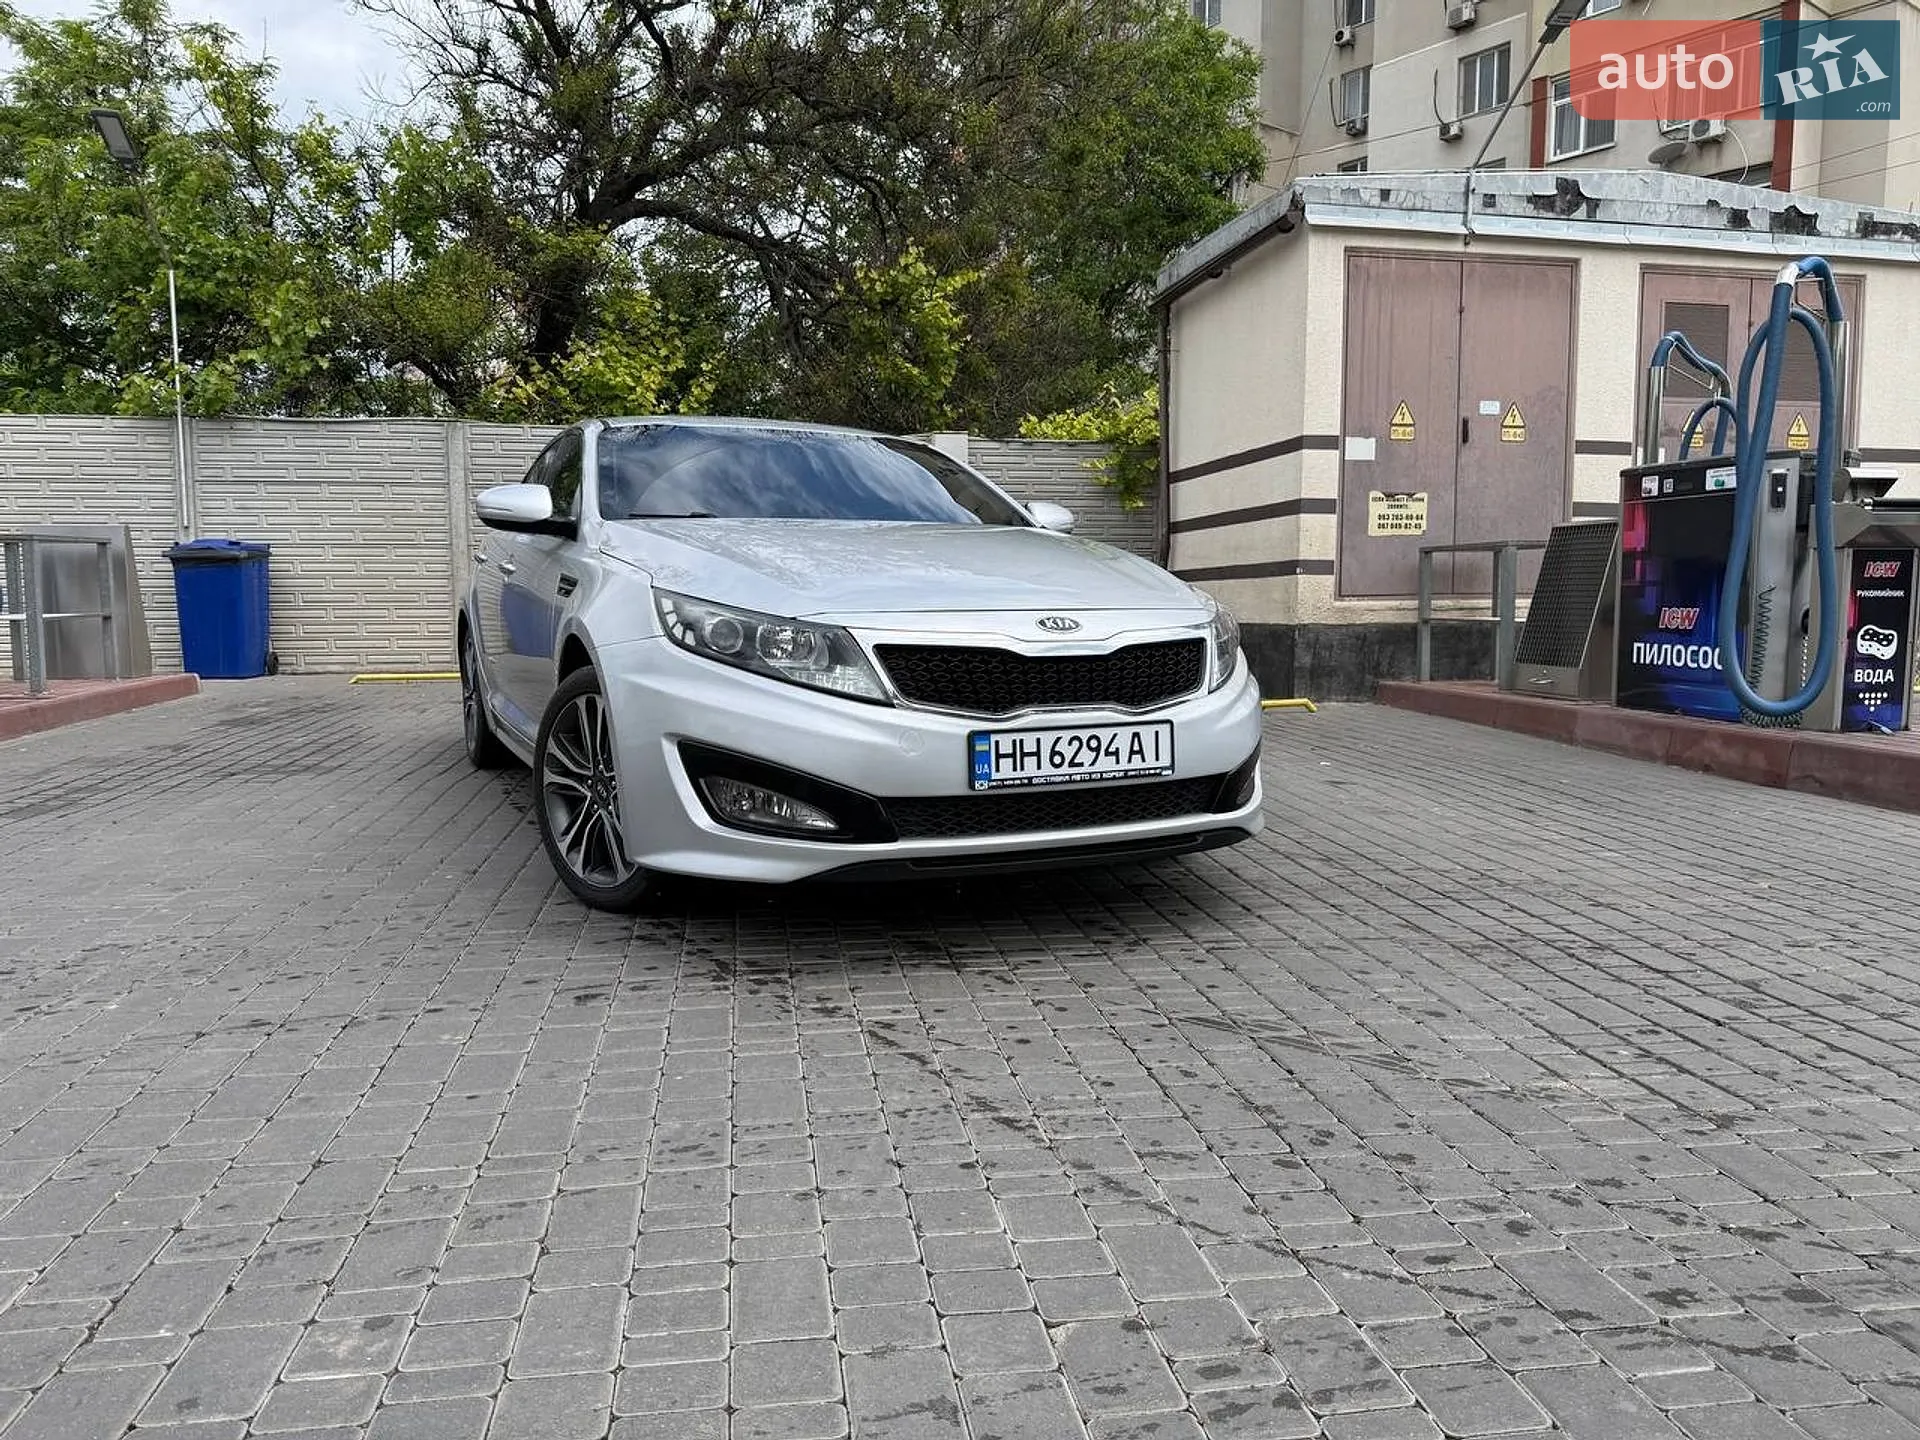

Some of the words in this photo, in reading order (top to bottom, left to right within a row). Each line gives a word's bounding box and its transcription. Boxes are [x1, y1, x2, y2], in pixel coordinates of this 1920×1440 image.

[1863, 561, 1900, 578] ICW
[1043, 617, 1078, 629] KIA
[1659, 607, 1700, 629] ICW
[1854, 669, 1895, 684] ВОДА
[976, 764, 990, 774] UA
